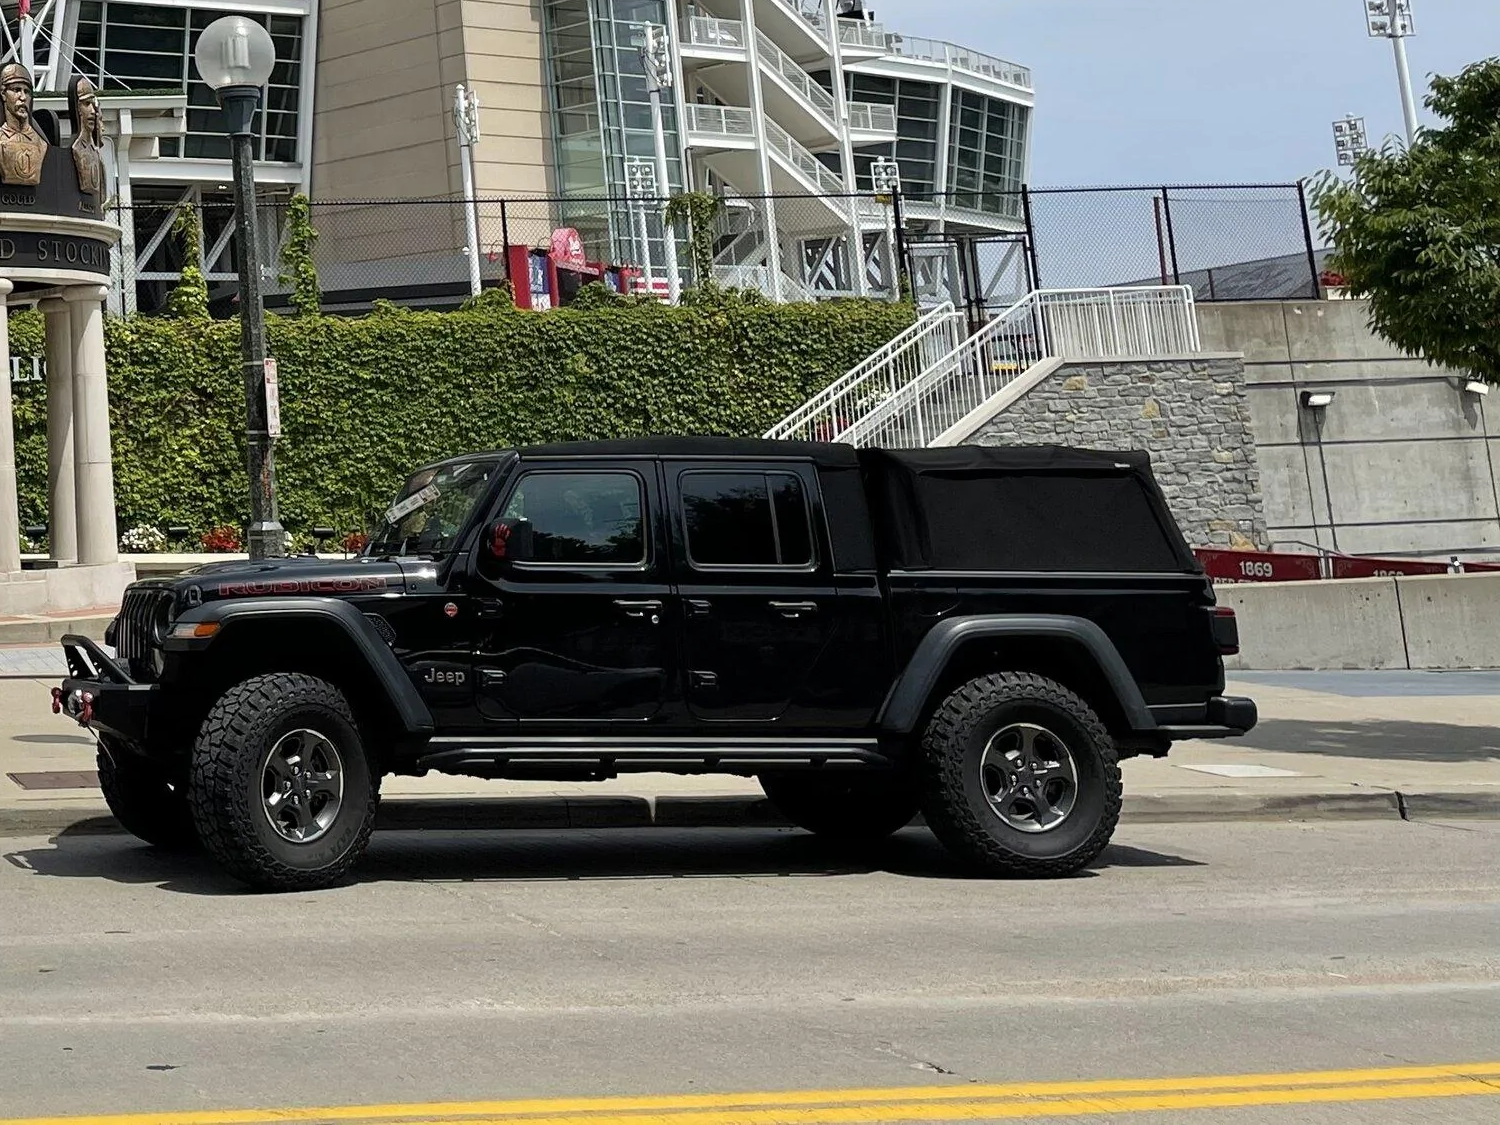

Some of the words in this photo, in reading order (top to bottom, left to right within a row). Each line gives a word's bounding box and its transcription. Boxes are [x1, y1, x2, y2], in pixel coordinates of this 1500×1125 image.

[1, 193, 36, 206] GOULD
[1239, 561, 1273, 577] 1869
[218, 578, 388, 595] RUBICON
[424, 668, 466, 686] Jeep
